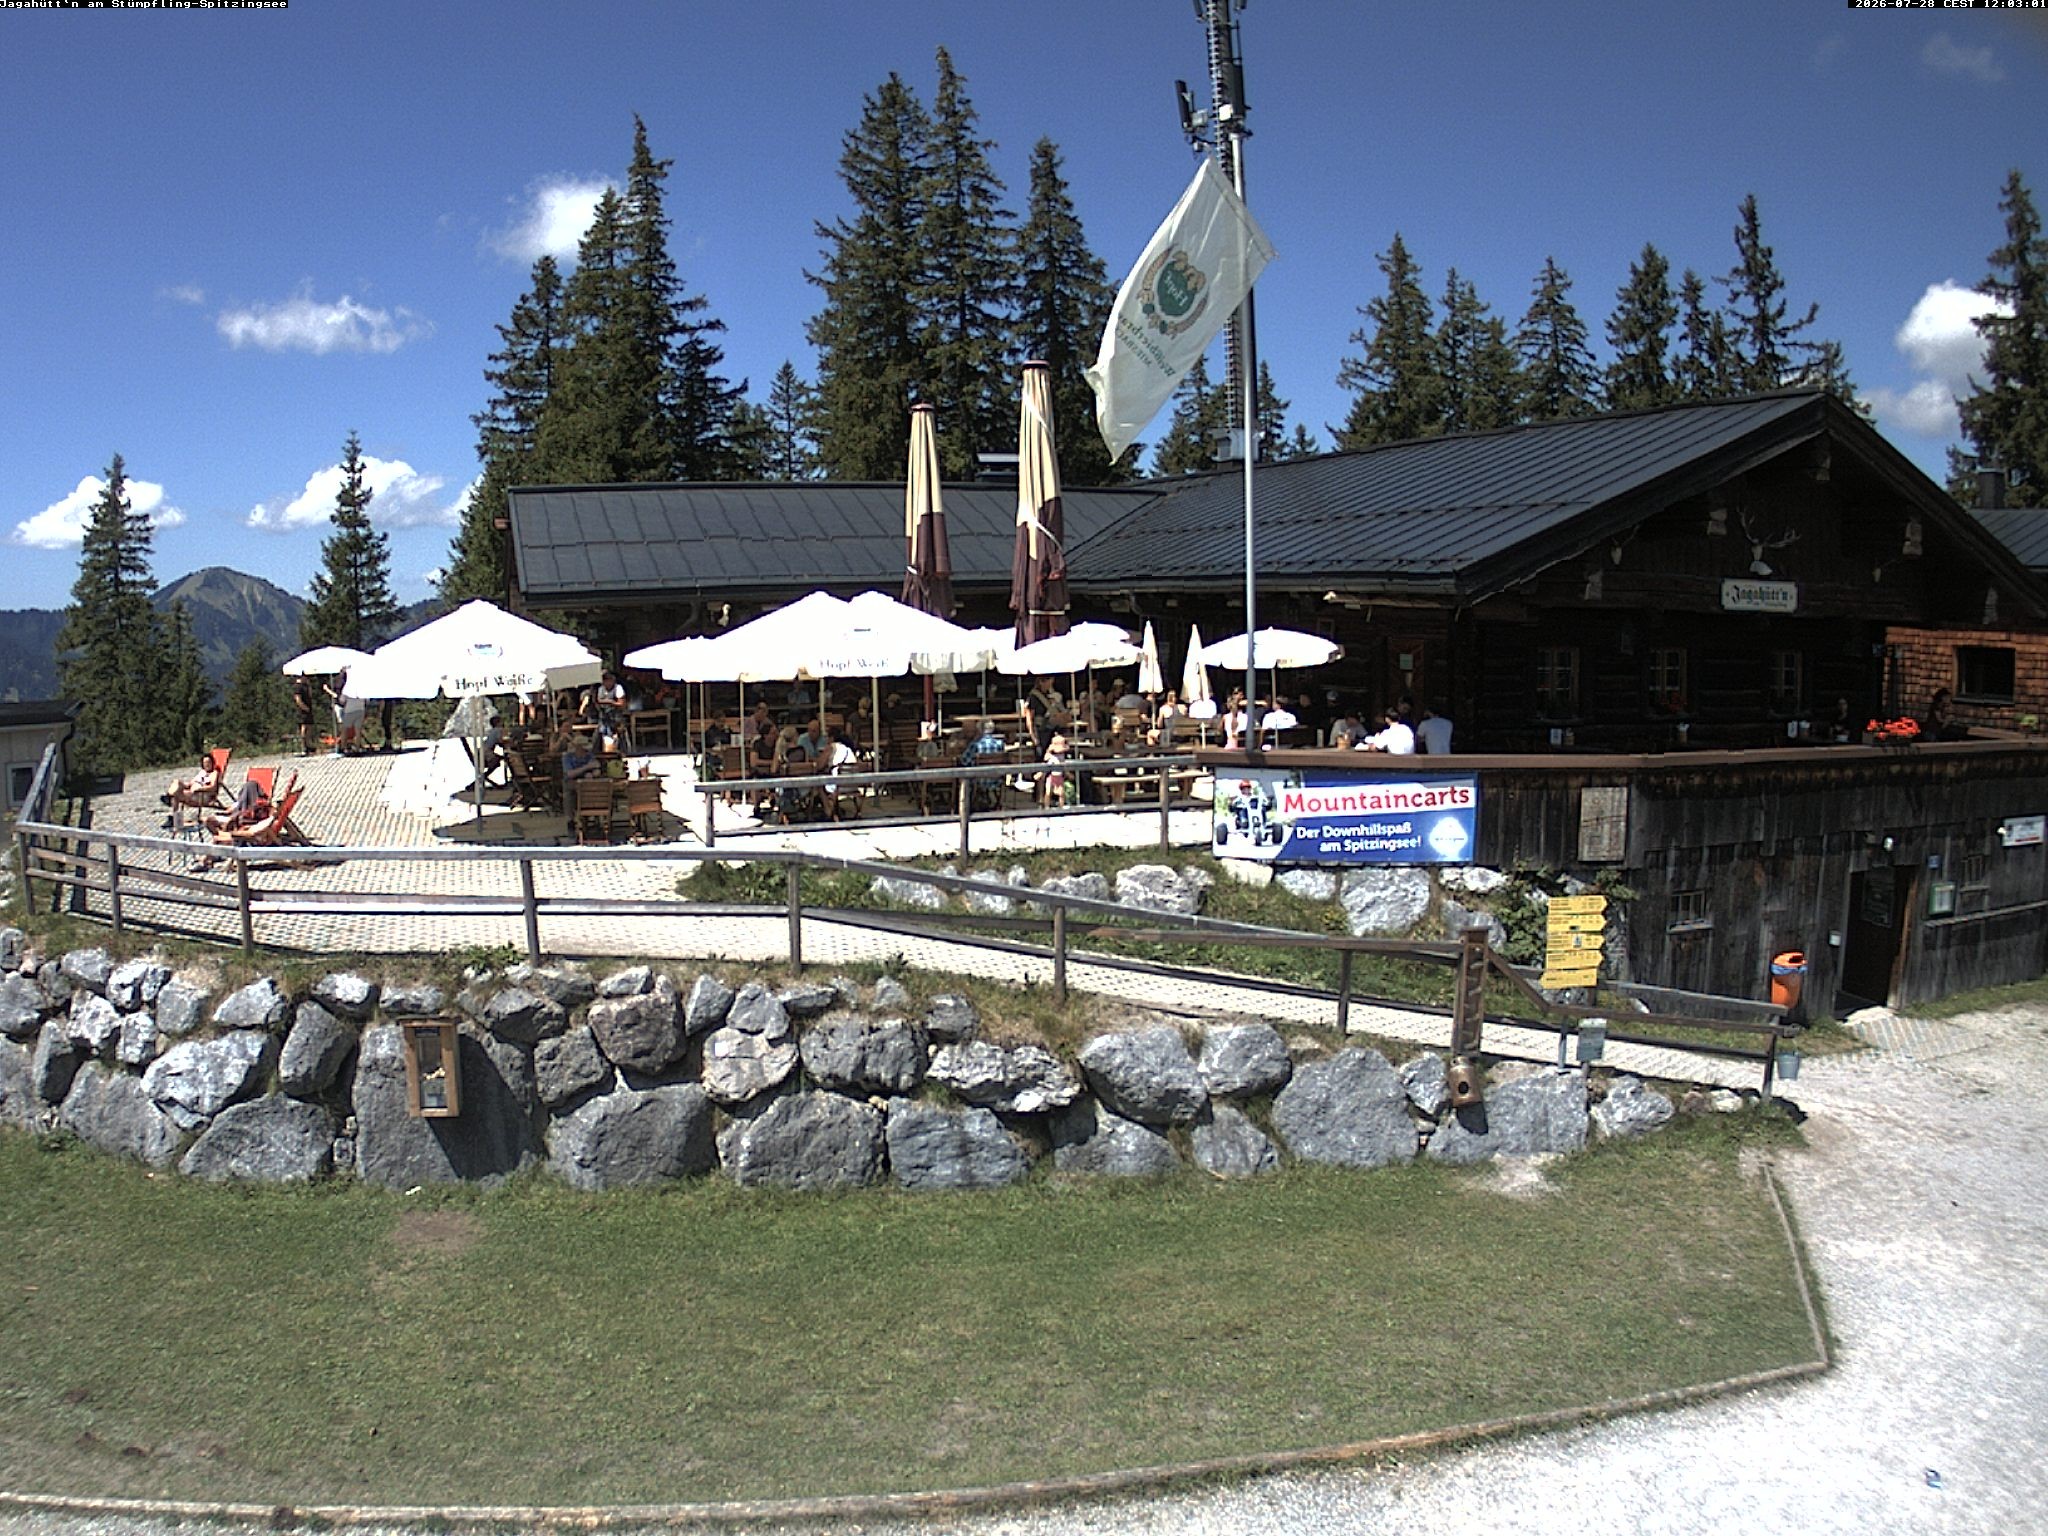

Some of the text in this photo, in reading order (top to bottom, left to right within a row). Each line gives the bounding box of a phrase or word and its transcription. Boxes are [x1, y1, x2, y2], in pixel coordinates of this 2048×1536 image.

[1284, 785, 1469, 813] Mountaincarts
[1296, 822, 1412, 839] Der Downhillspaß
[1319, 835, 1421, 854] am Spitzingsee!
